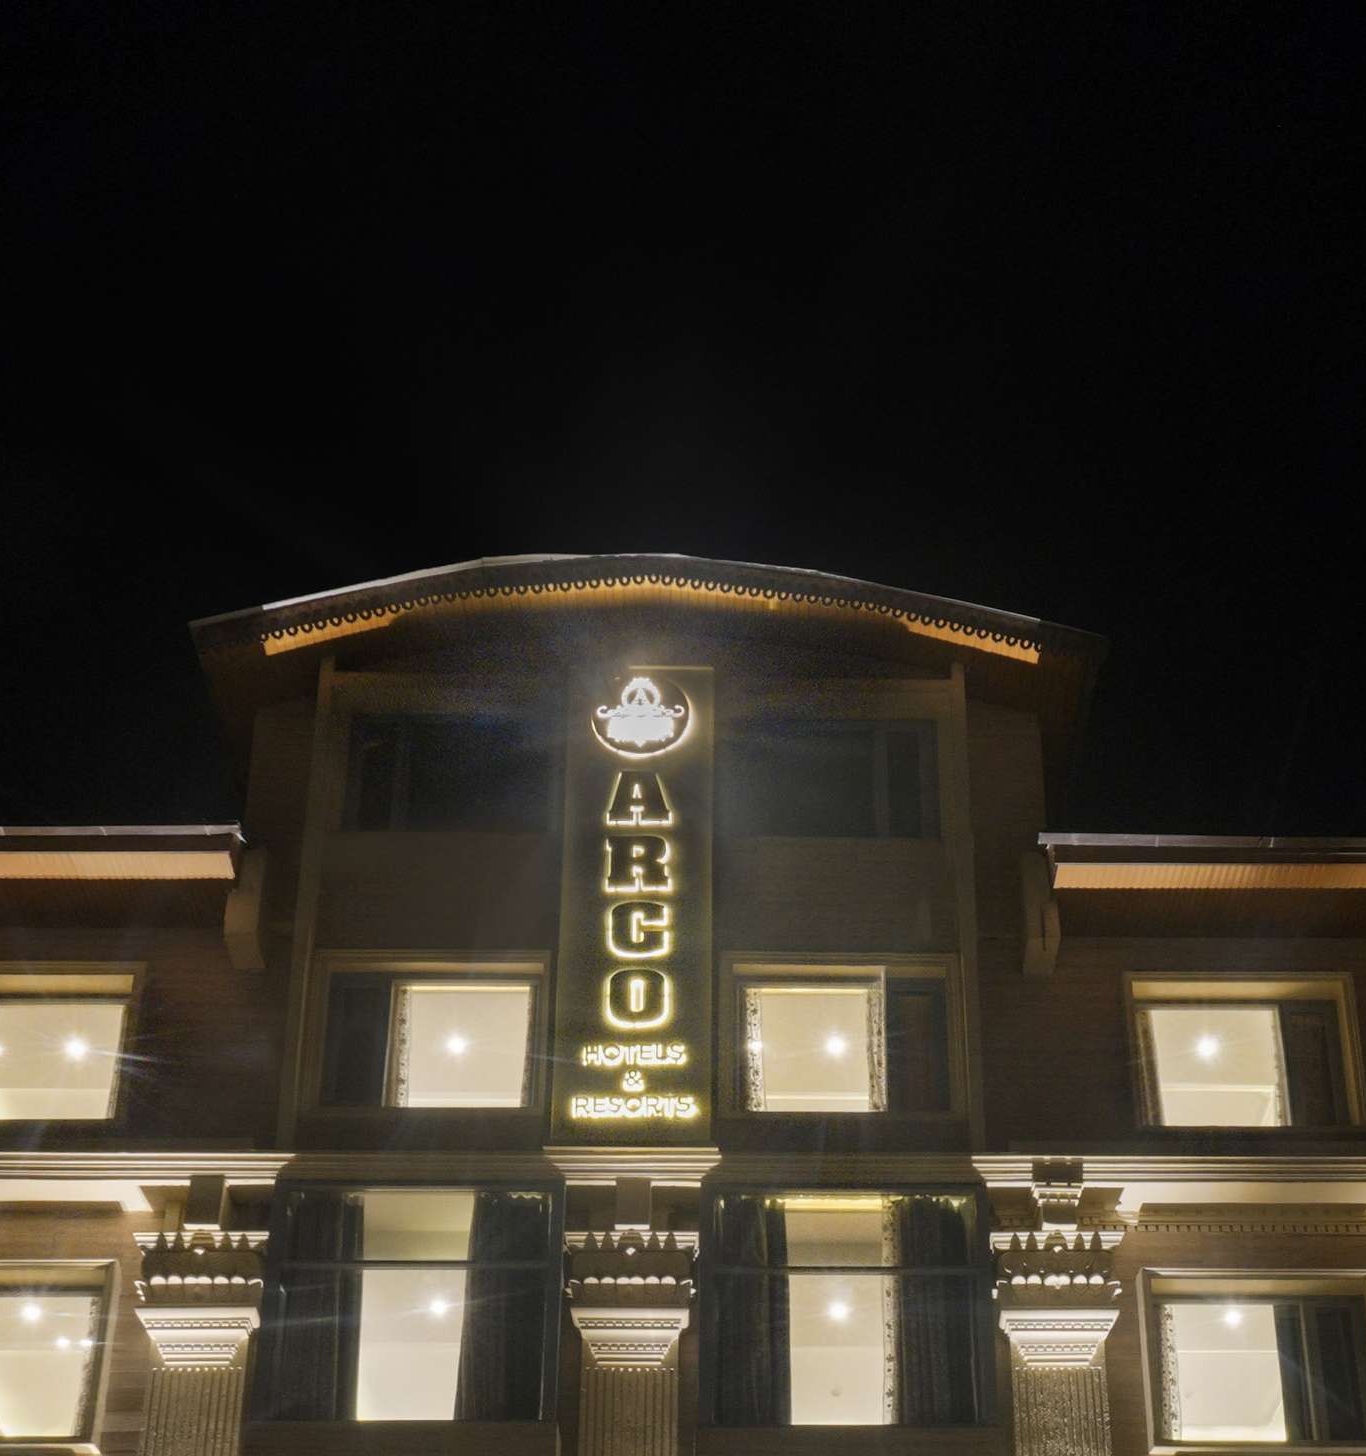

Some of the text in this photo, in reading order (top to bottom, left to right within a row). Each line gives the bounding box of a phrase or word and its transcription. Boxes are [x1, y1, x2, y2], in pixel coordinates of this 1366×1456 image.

[605, 768, 672, 1028] ARCO
[582, 1042, 686, 1065] HOTELS
[622, 1069, 645, 1091] &
[572, 1095, 699, 1118] RESORTS
